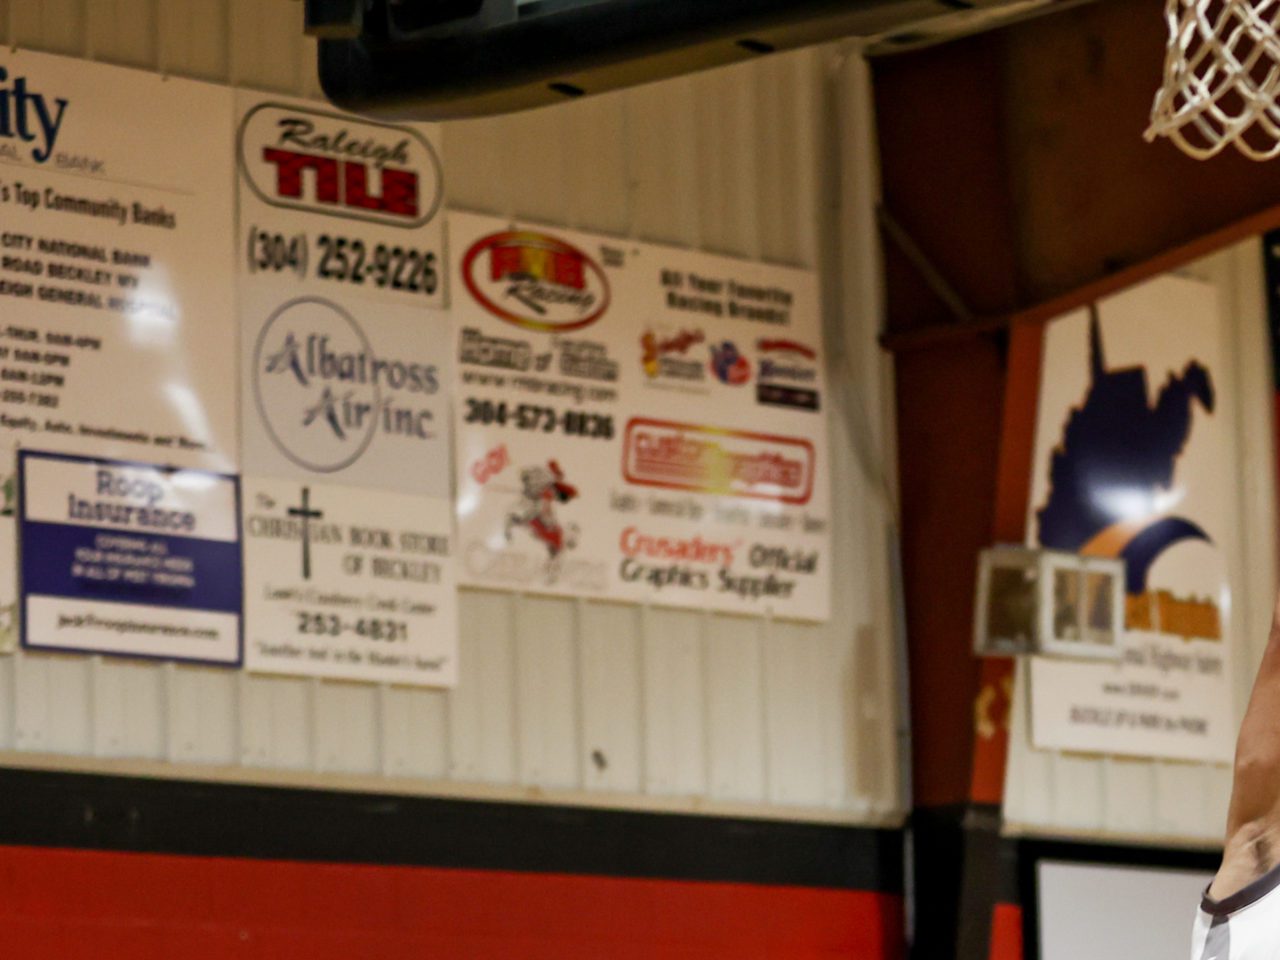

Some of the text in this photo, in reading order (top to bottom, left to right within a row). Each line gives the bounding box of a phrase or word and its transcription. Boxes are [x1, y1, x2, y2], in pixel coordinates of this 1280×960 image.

[277, 118, 409, 166] Raleigh
[262, 147, 418, 217] TILE
[15, 182, 40, 212] Top
[45, 187, 127, 226] Community
[133, 202, 177, 229] Banks
[1, 232, 33, 249] CITY
[38, 238, 107, 263] NATIONAL
[247, 225, 308, 278] (304)
[316, 234, 438, 296] 252-9226
[48, 263, 112, 285] BECKLEY
[38, 286, 103, 309] GENERAL
[265, 330, 440, 396] Albatross
[303, 386, 371, 441] Air
[97, 471, 164, 506] Roop
[618, 560, 709, 594] Graphics
[716, 568, 798, 600] Supplier
[748, 544, 819, 575] Official
